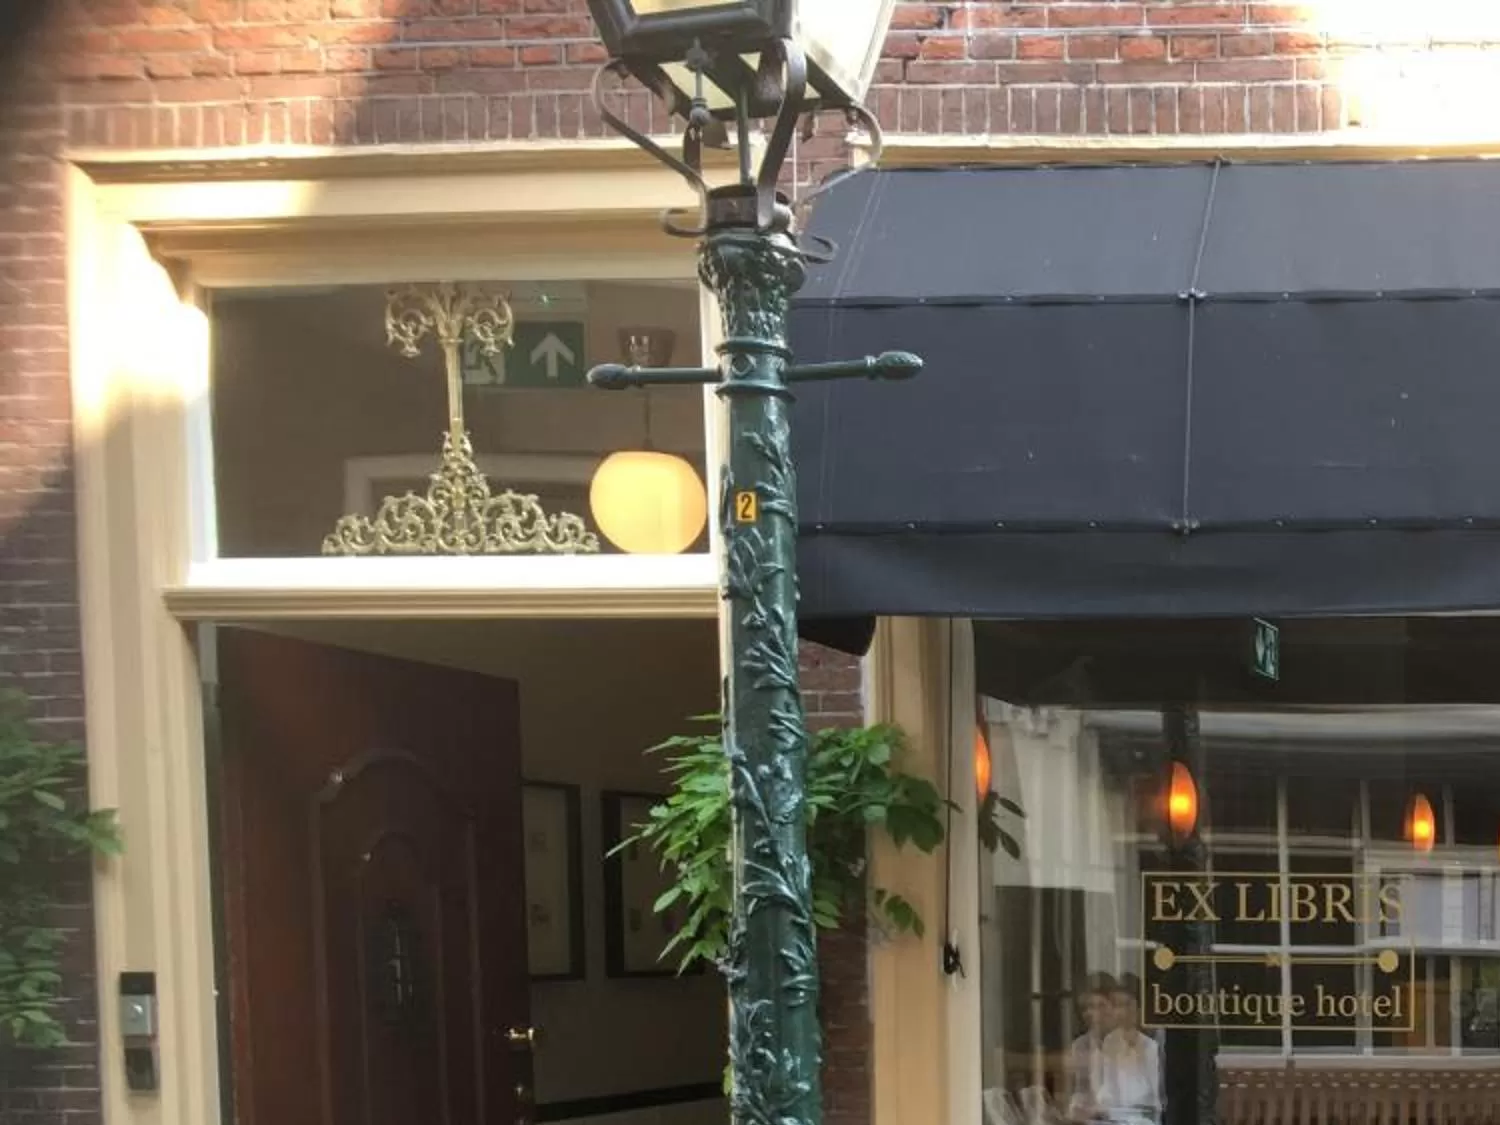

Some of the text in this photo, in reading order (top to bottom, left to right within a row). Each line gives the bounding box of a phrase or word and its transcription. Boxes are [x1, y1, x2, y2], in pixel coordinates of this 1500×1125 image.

[741, 493, 753, 519] 2
[1151, 882, 1402, 923] EX LIBRIS
[1151, 984, 1402, 1024] boutique hotel
